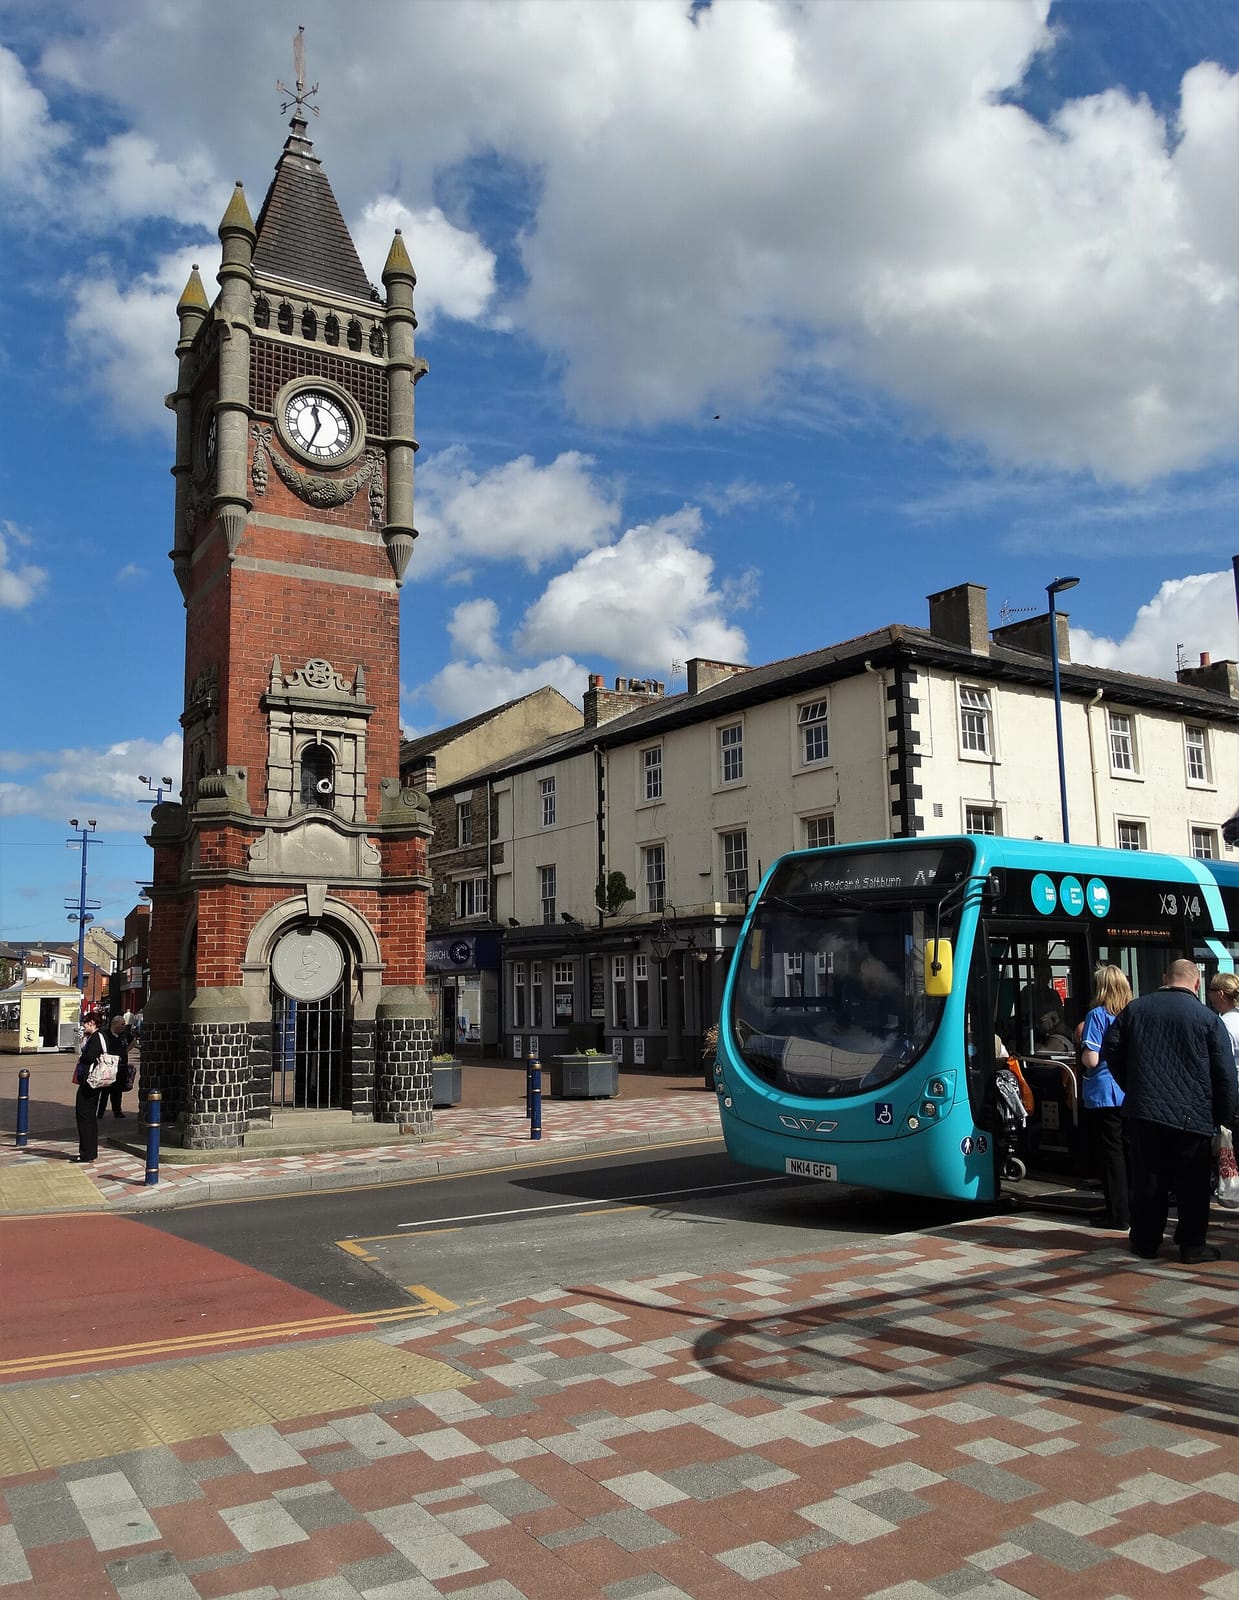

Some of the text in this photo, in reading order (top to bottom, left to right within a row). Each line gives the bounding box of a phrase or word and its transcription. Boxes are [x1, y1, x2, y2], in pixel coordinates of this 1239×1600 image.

[862, 876, 902, 889] Saltburn
[1158, 893, 1200, 917] X3 X4
[790, 1160, 811, 1175] NK14
